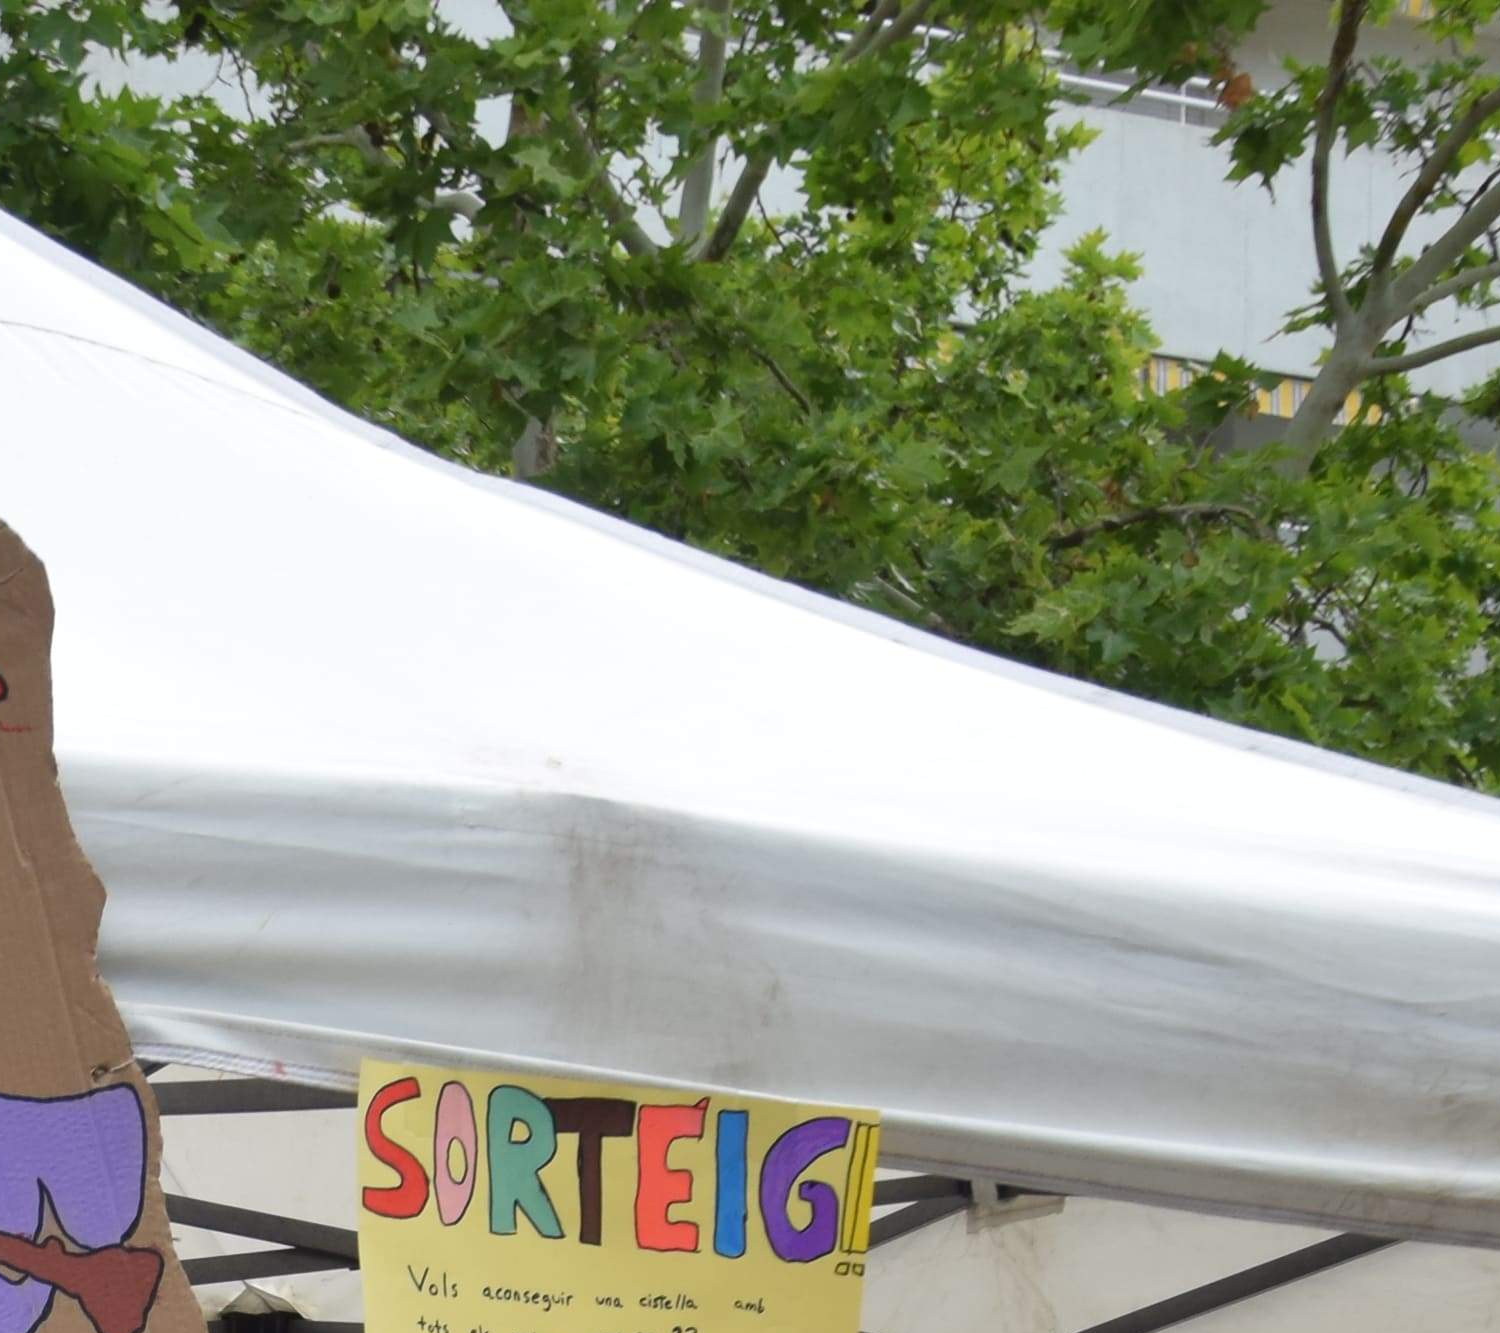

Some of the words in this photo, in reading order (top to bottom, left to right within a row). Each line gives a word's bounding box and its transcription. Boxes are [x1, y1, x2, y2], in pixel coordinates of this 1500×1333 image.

[407, 1264, 458, 1299] Vols
[482, 1285, 574, 1312] aconseguir
[595, 1296, 624, 1309] una
[638, 1293, 698, 1310] cistella
[733, 1297, 765, 1315] amb
